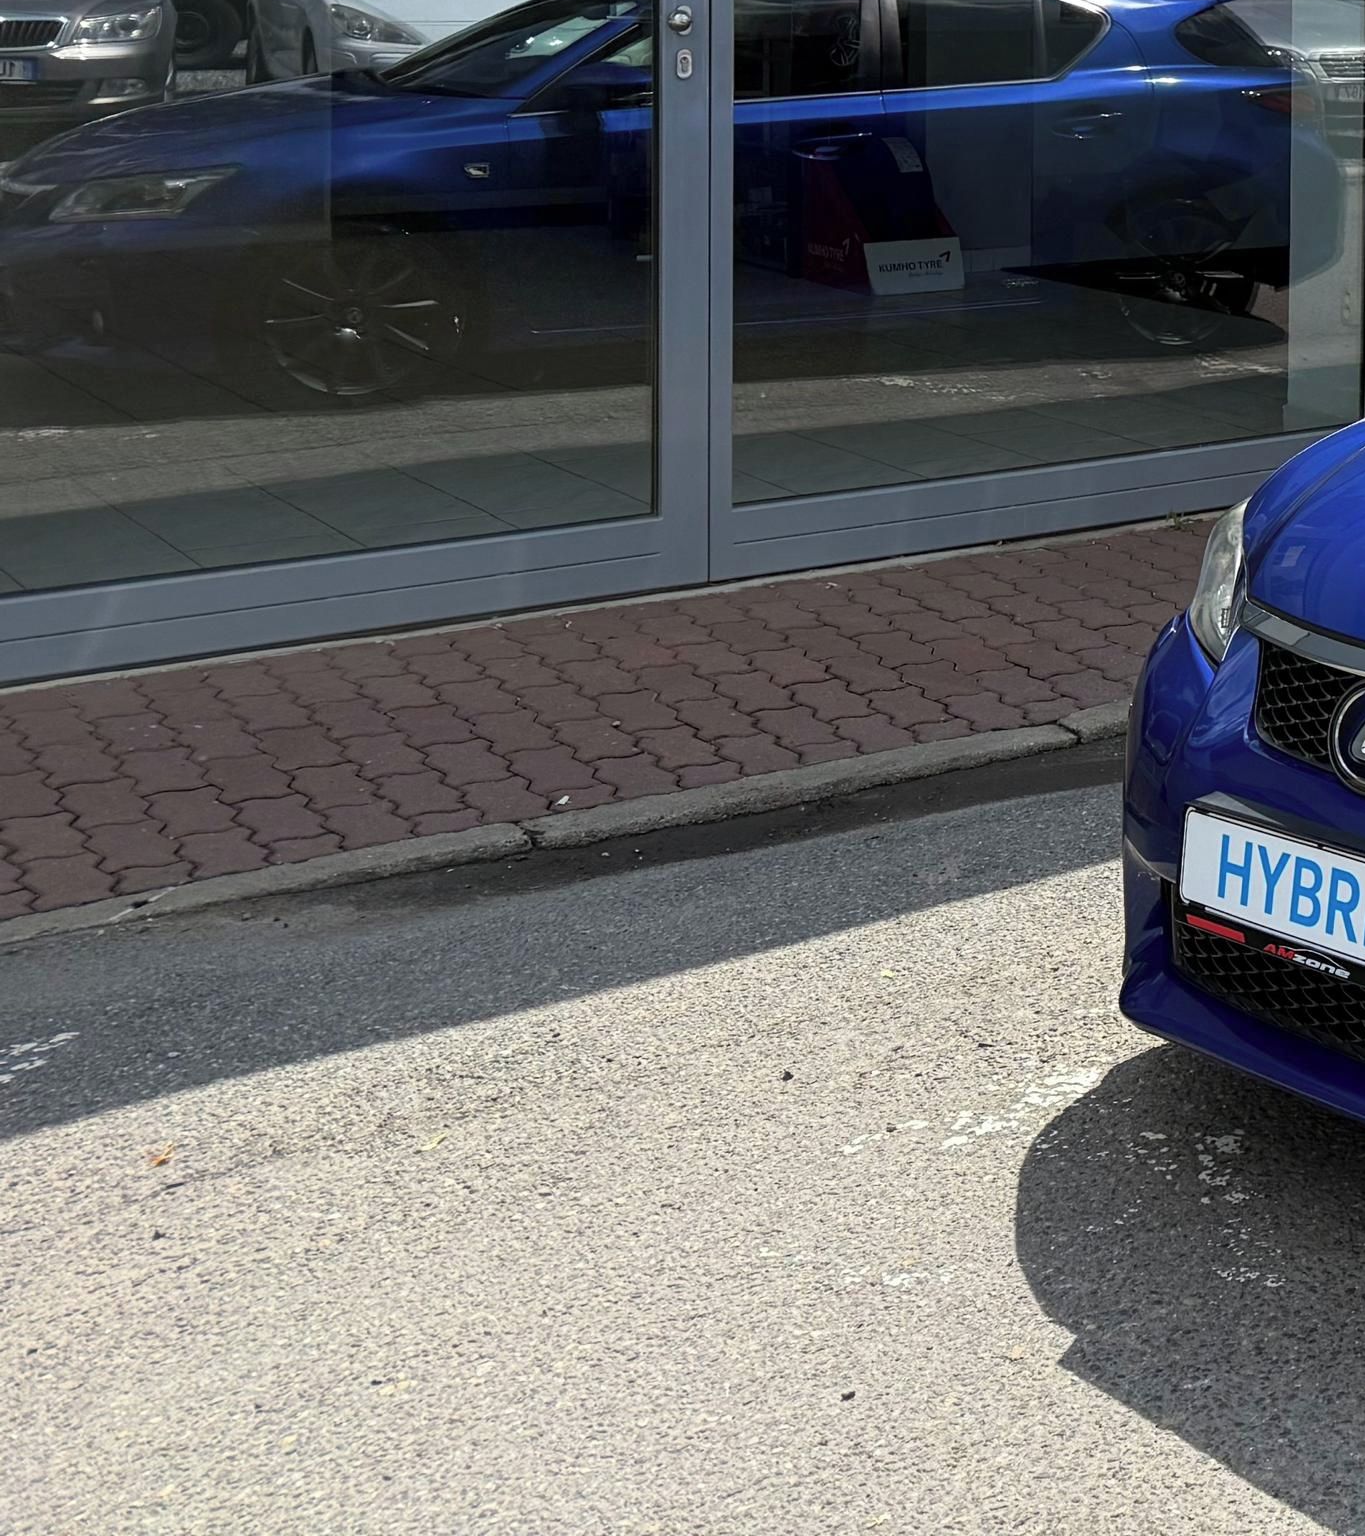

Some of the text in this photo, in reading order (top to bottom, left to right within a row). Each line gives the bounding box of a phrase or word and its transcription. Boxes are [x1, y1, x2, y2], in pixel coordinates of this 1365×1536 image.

[878, 259, 944, 273] KUMHO TYRE
[1263, 943, 1350, 979] AMzone
